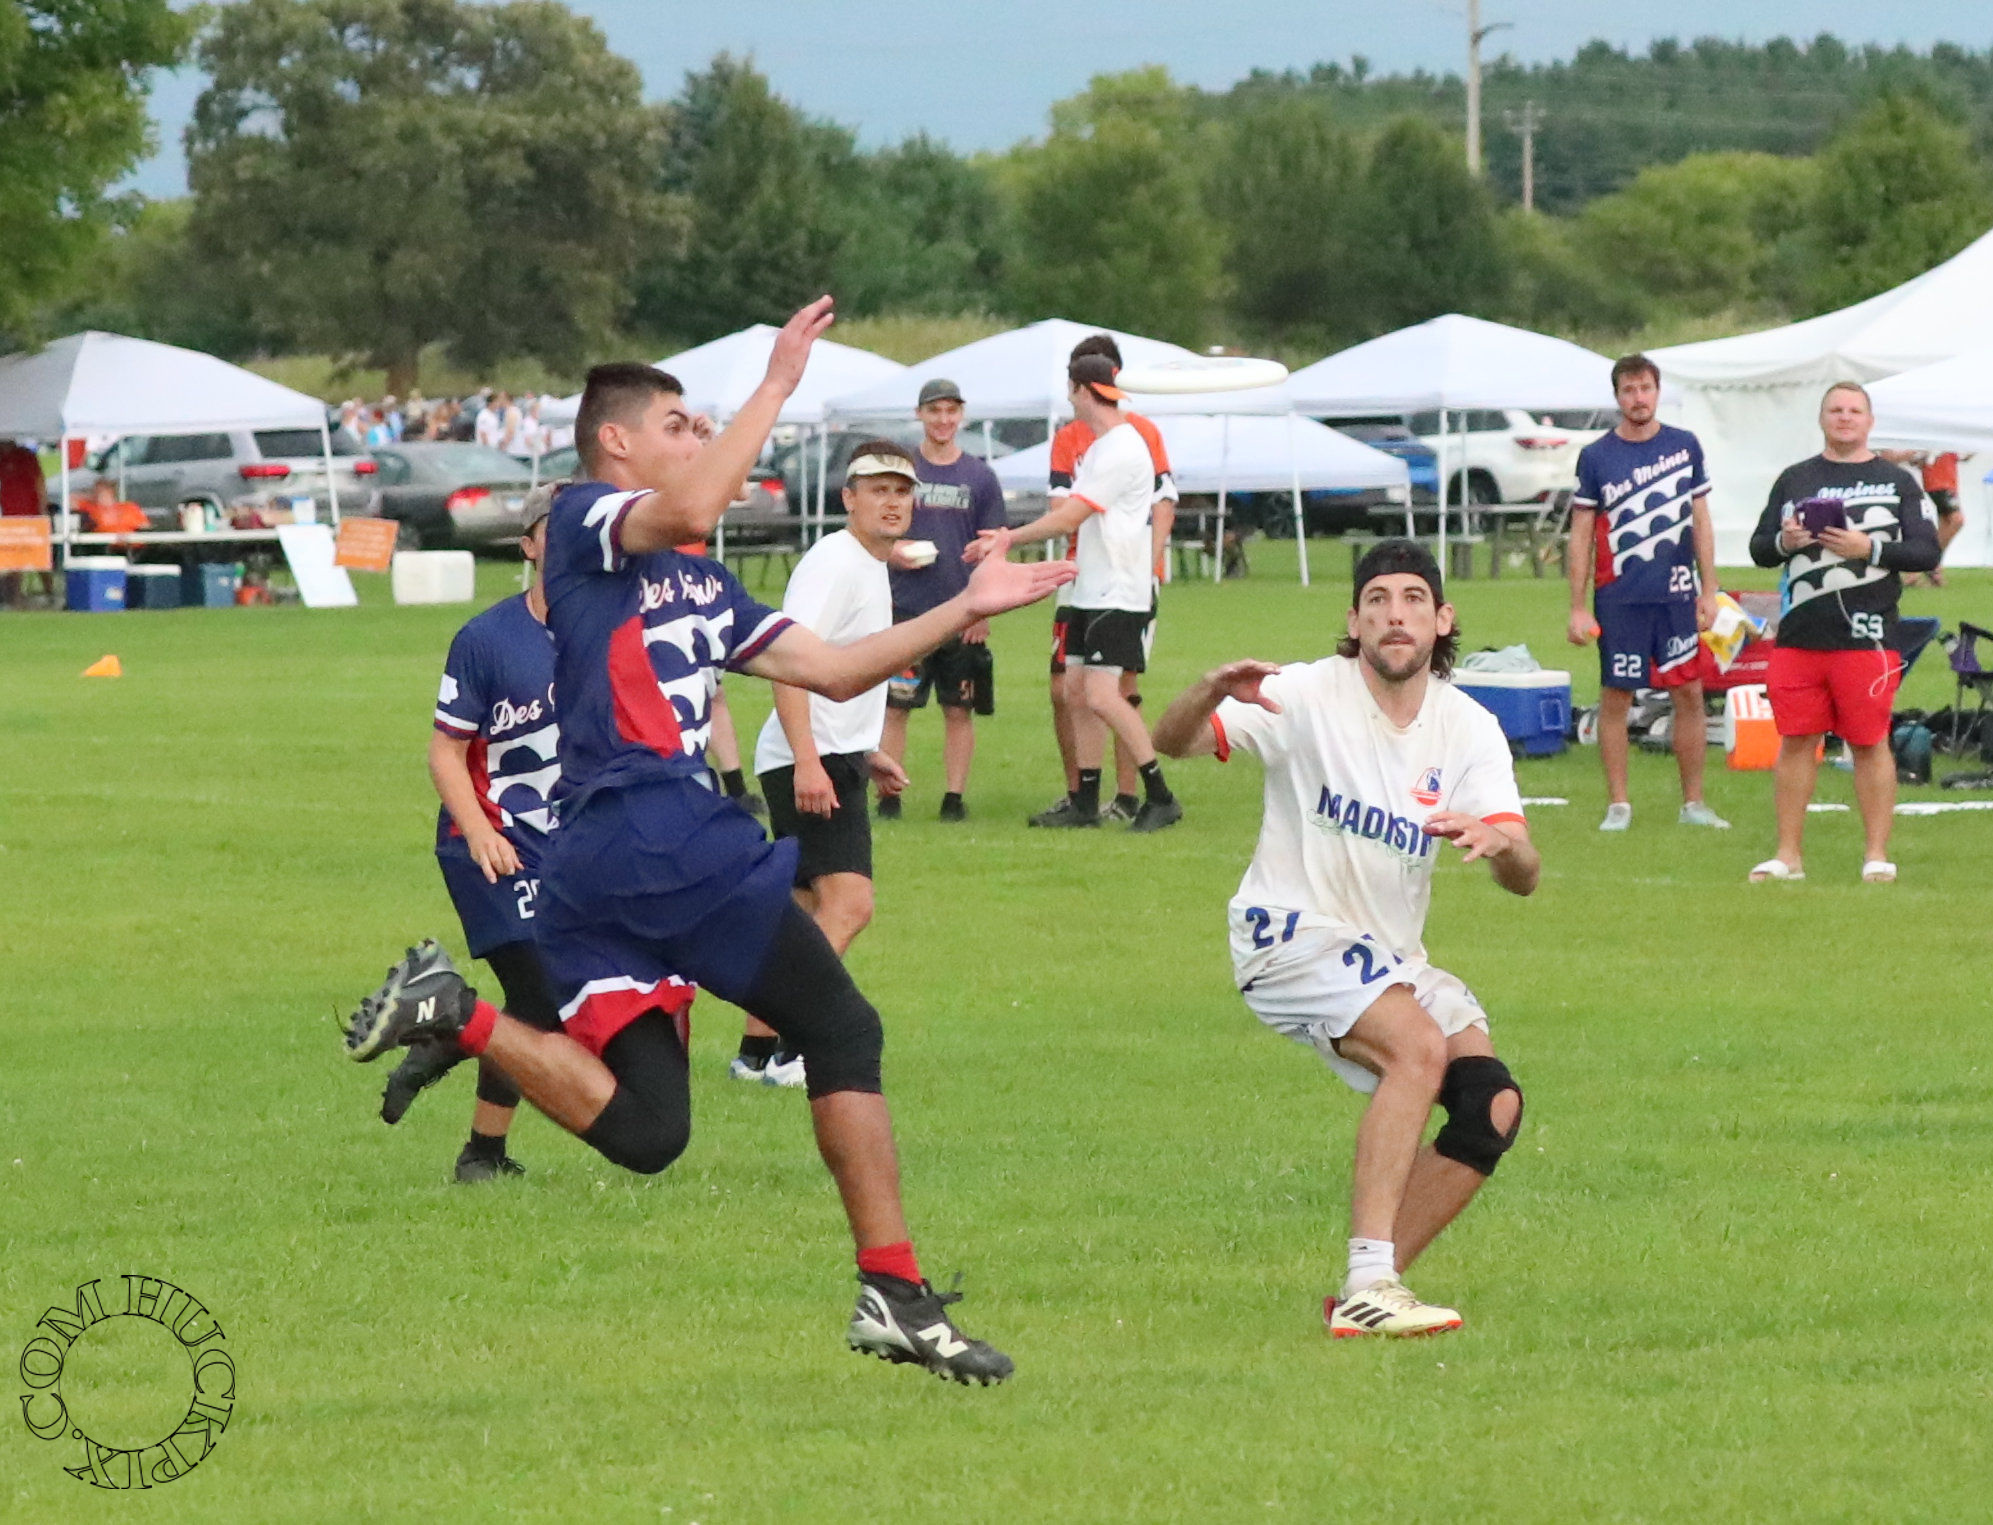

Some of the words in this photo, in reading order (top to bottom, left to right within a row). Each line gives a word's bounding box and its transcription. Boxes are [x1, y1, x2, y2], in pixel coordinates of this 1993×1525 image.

[1632, 448, 1691, 486] Moines
[1669, 565, 1693, 593] 22
[1613, 653, 1642, 678] 22
[490, 697, 542, 735] Des
